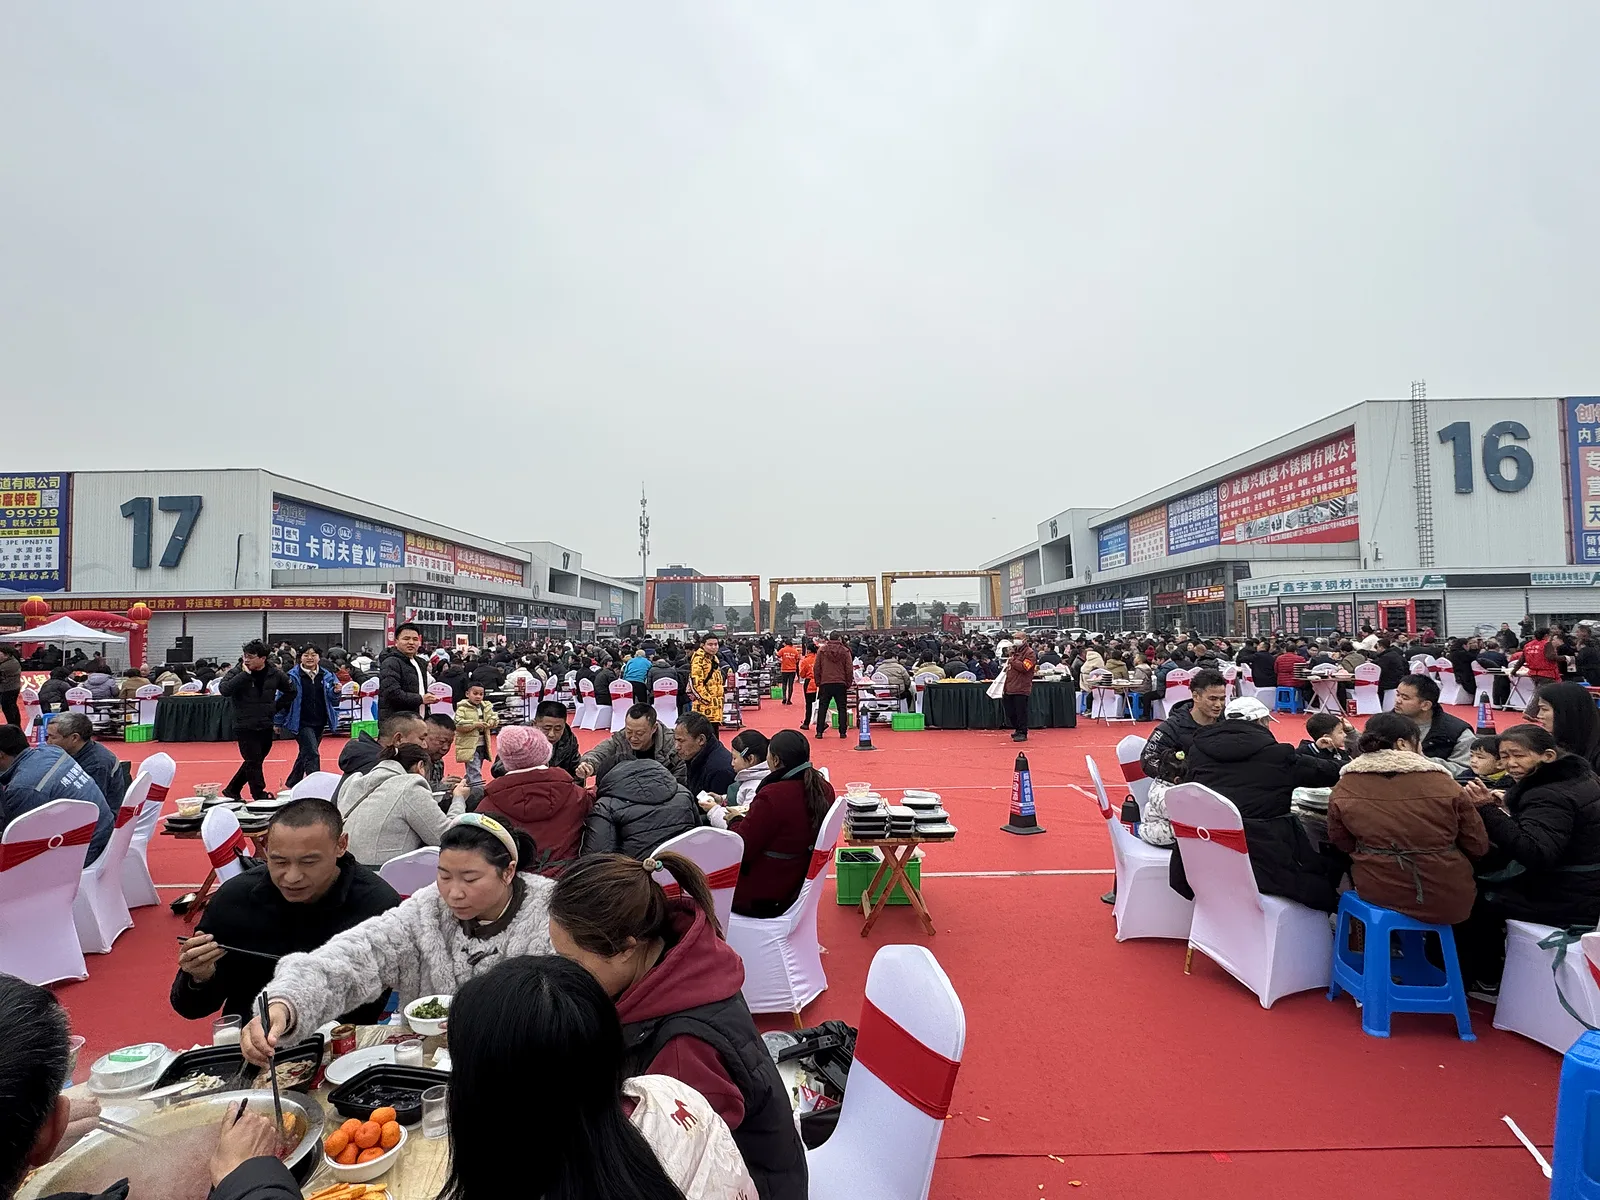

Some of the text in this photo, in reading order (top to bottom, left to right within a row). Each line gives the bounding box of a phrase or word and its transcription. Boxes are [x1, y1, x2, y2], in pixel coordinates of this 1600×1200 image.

[1437, 420, 1534, 494] 16
[0, 493, 37, 506] 腐钢管
[5, 508, 59, 518] 99999
[120, 495, 203, 568] 17
[306, 535, 376, 566] 卡耐夫管业
